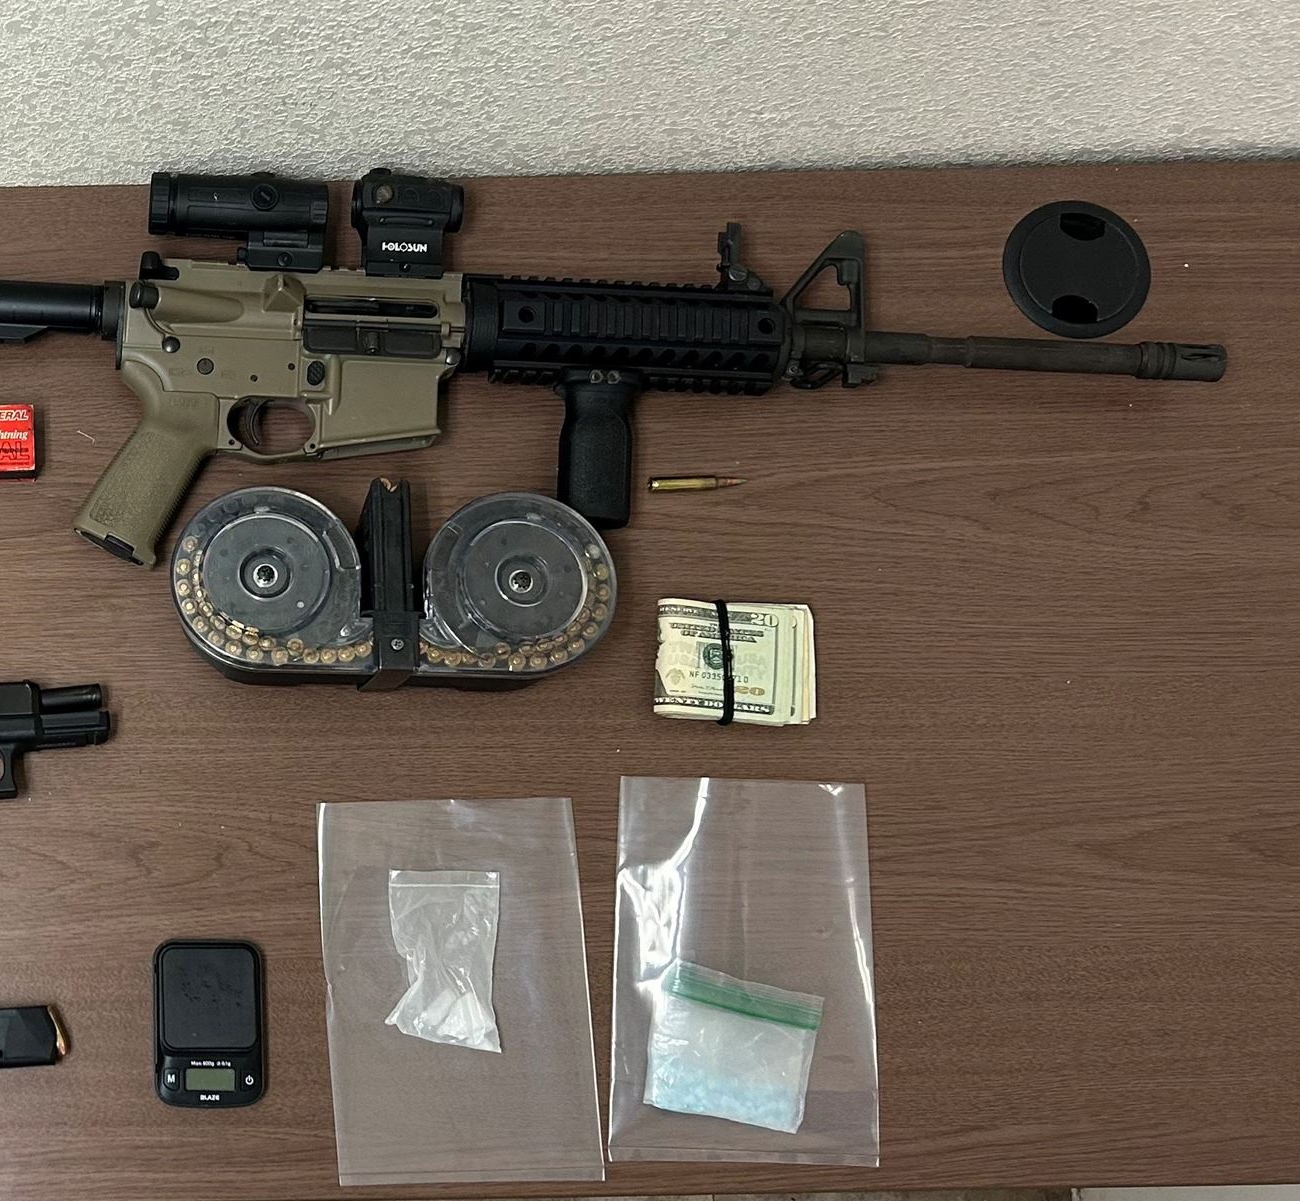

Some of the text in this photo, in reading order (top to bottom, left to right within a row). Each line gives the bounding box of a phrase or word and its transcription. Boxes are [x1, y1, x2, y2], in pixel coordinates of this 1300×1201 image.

[381, 241, 428, 253] HOLOSUN
[750, 612, 780, 628] 20
[701, 671, 742, 683] 033571
[654, 697, 770, 713] WENTY DOLARS
[167, 1074, 176, 1083] M
